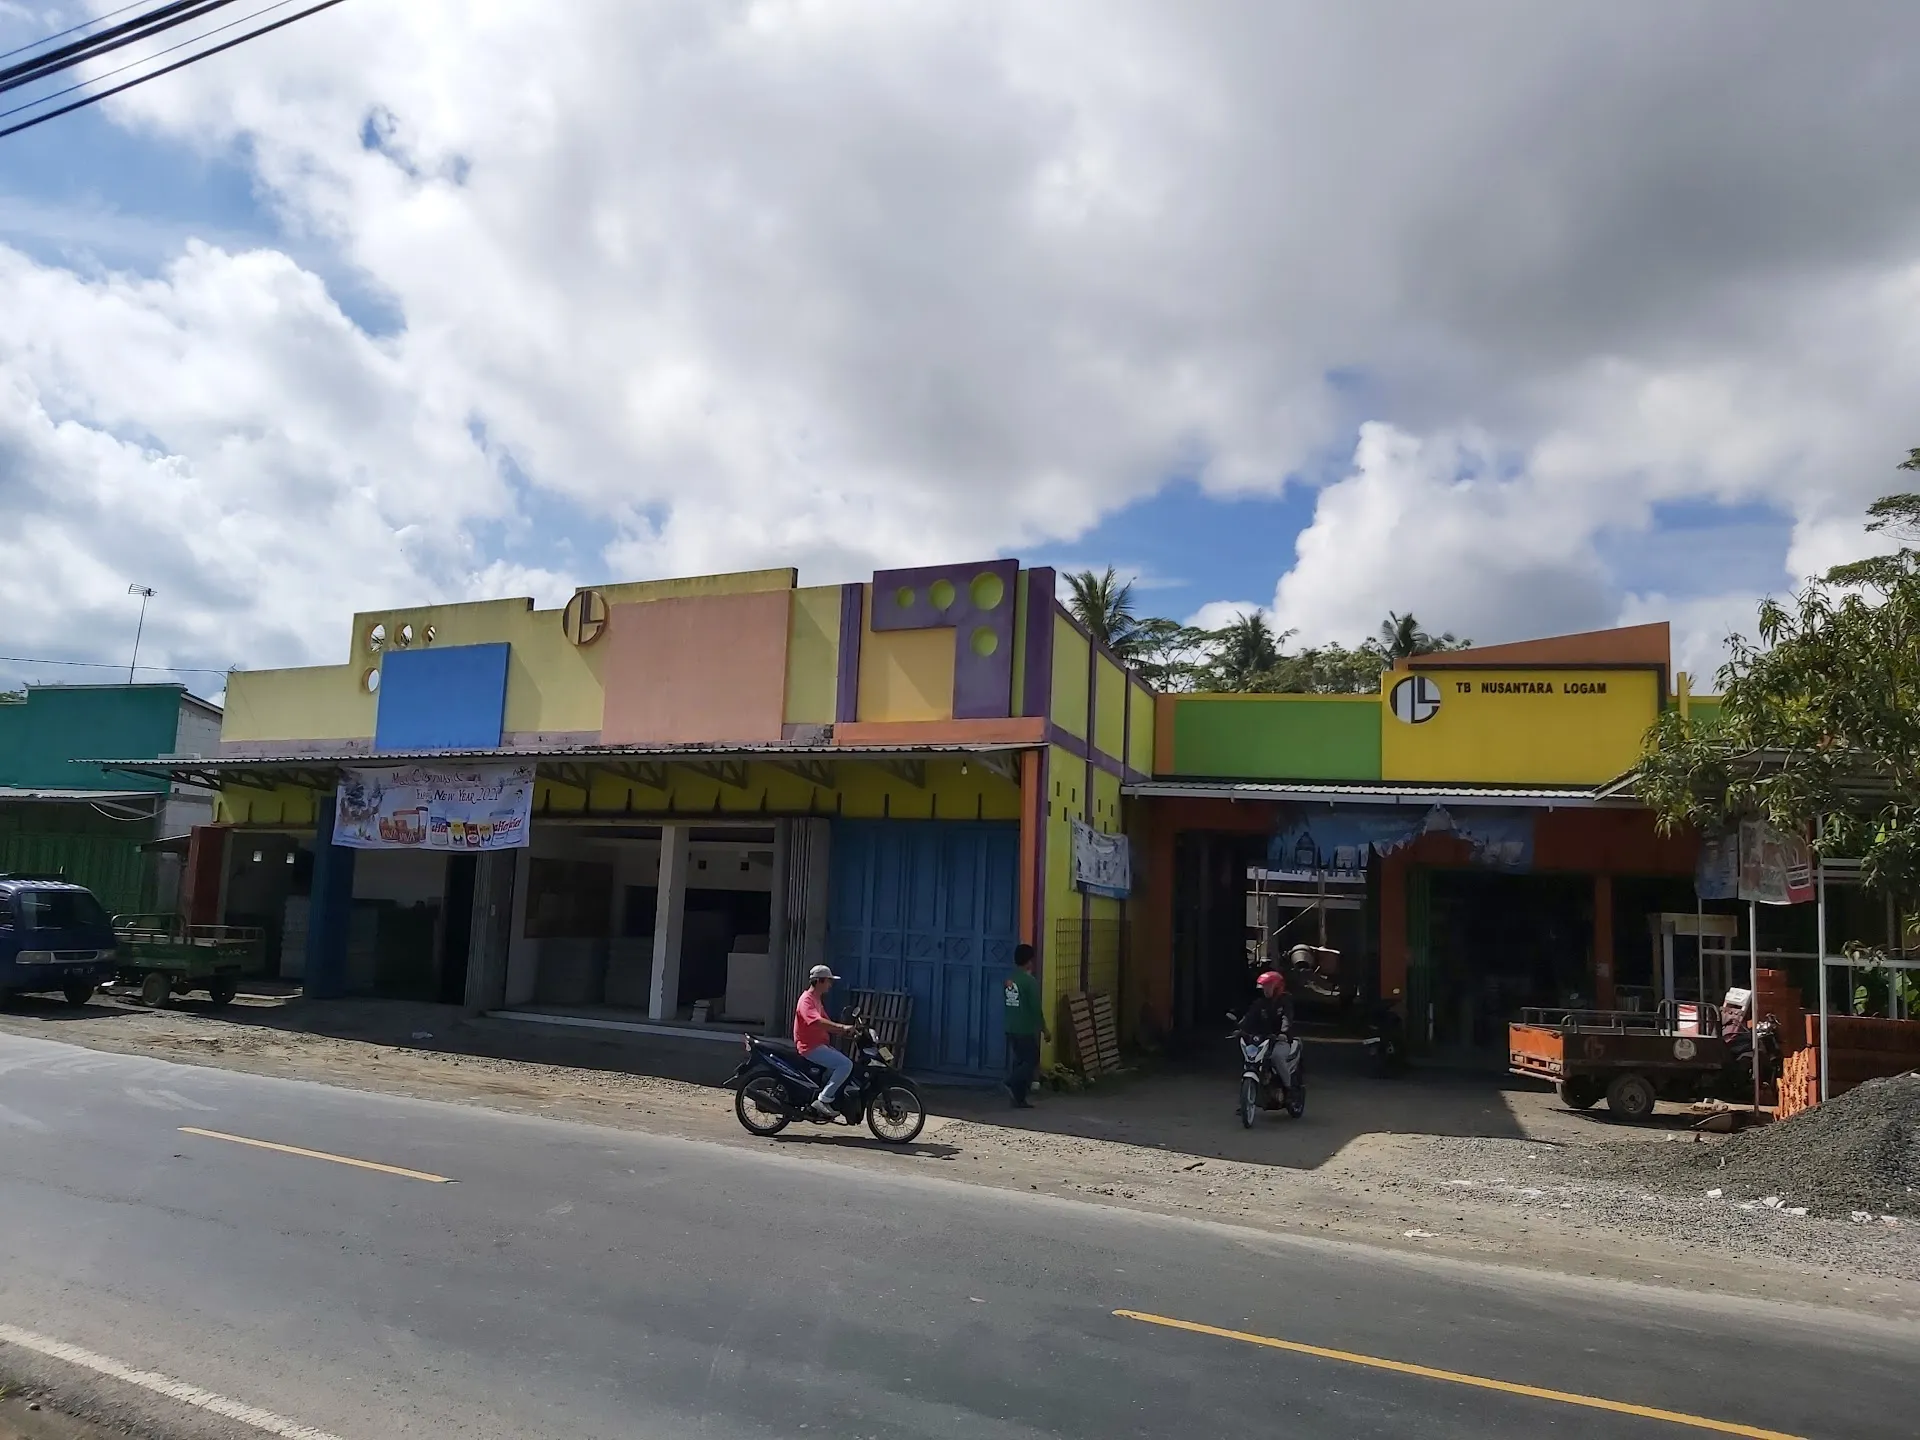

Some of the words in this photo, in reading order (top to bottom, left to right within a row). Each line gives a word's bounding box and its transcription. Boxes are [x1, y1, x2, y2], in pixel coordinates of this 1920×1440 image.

[1456, 682, 1471, 694] TB
[1481, 682, 1554, 694] NUSANTARA
[1563, 682, 1607, 694] LOGAM
[458, 789, 477, 804] YEAR
